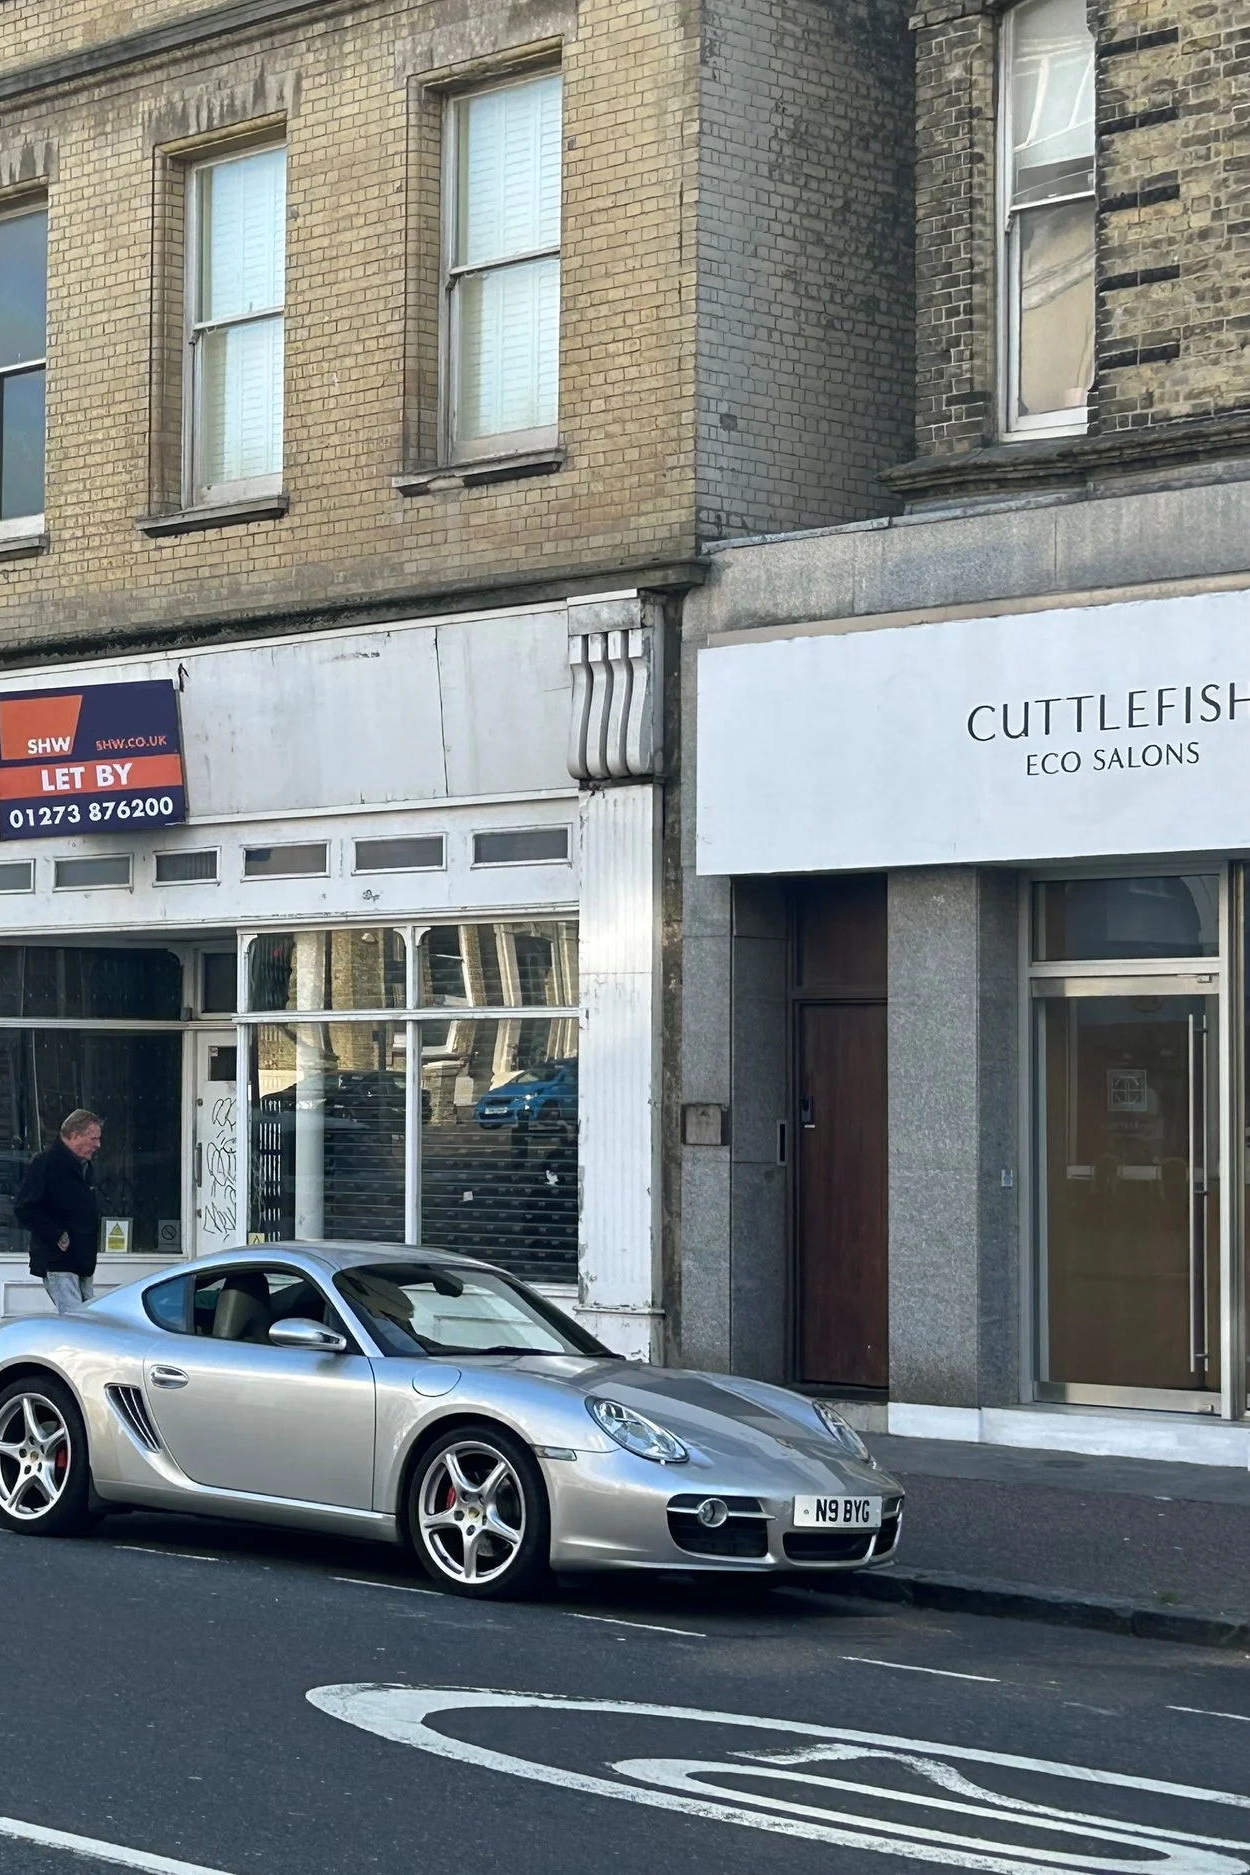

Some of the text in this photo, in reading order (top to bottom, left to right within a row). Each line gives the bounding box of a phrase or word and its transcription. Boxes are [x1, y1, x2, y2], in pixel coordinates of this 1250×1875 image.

[27, 736, 71, 754] SHW
[95, 735, 167, 751] SHW.CO.UK
[1026, 741, 1200, 776] ECO SALONS
[41, 763, 133, 791] LET BY
[9, 796, 174, 829] 01273 876200
[815, 1498, 871, 1523] N9 BYG
